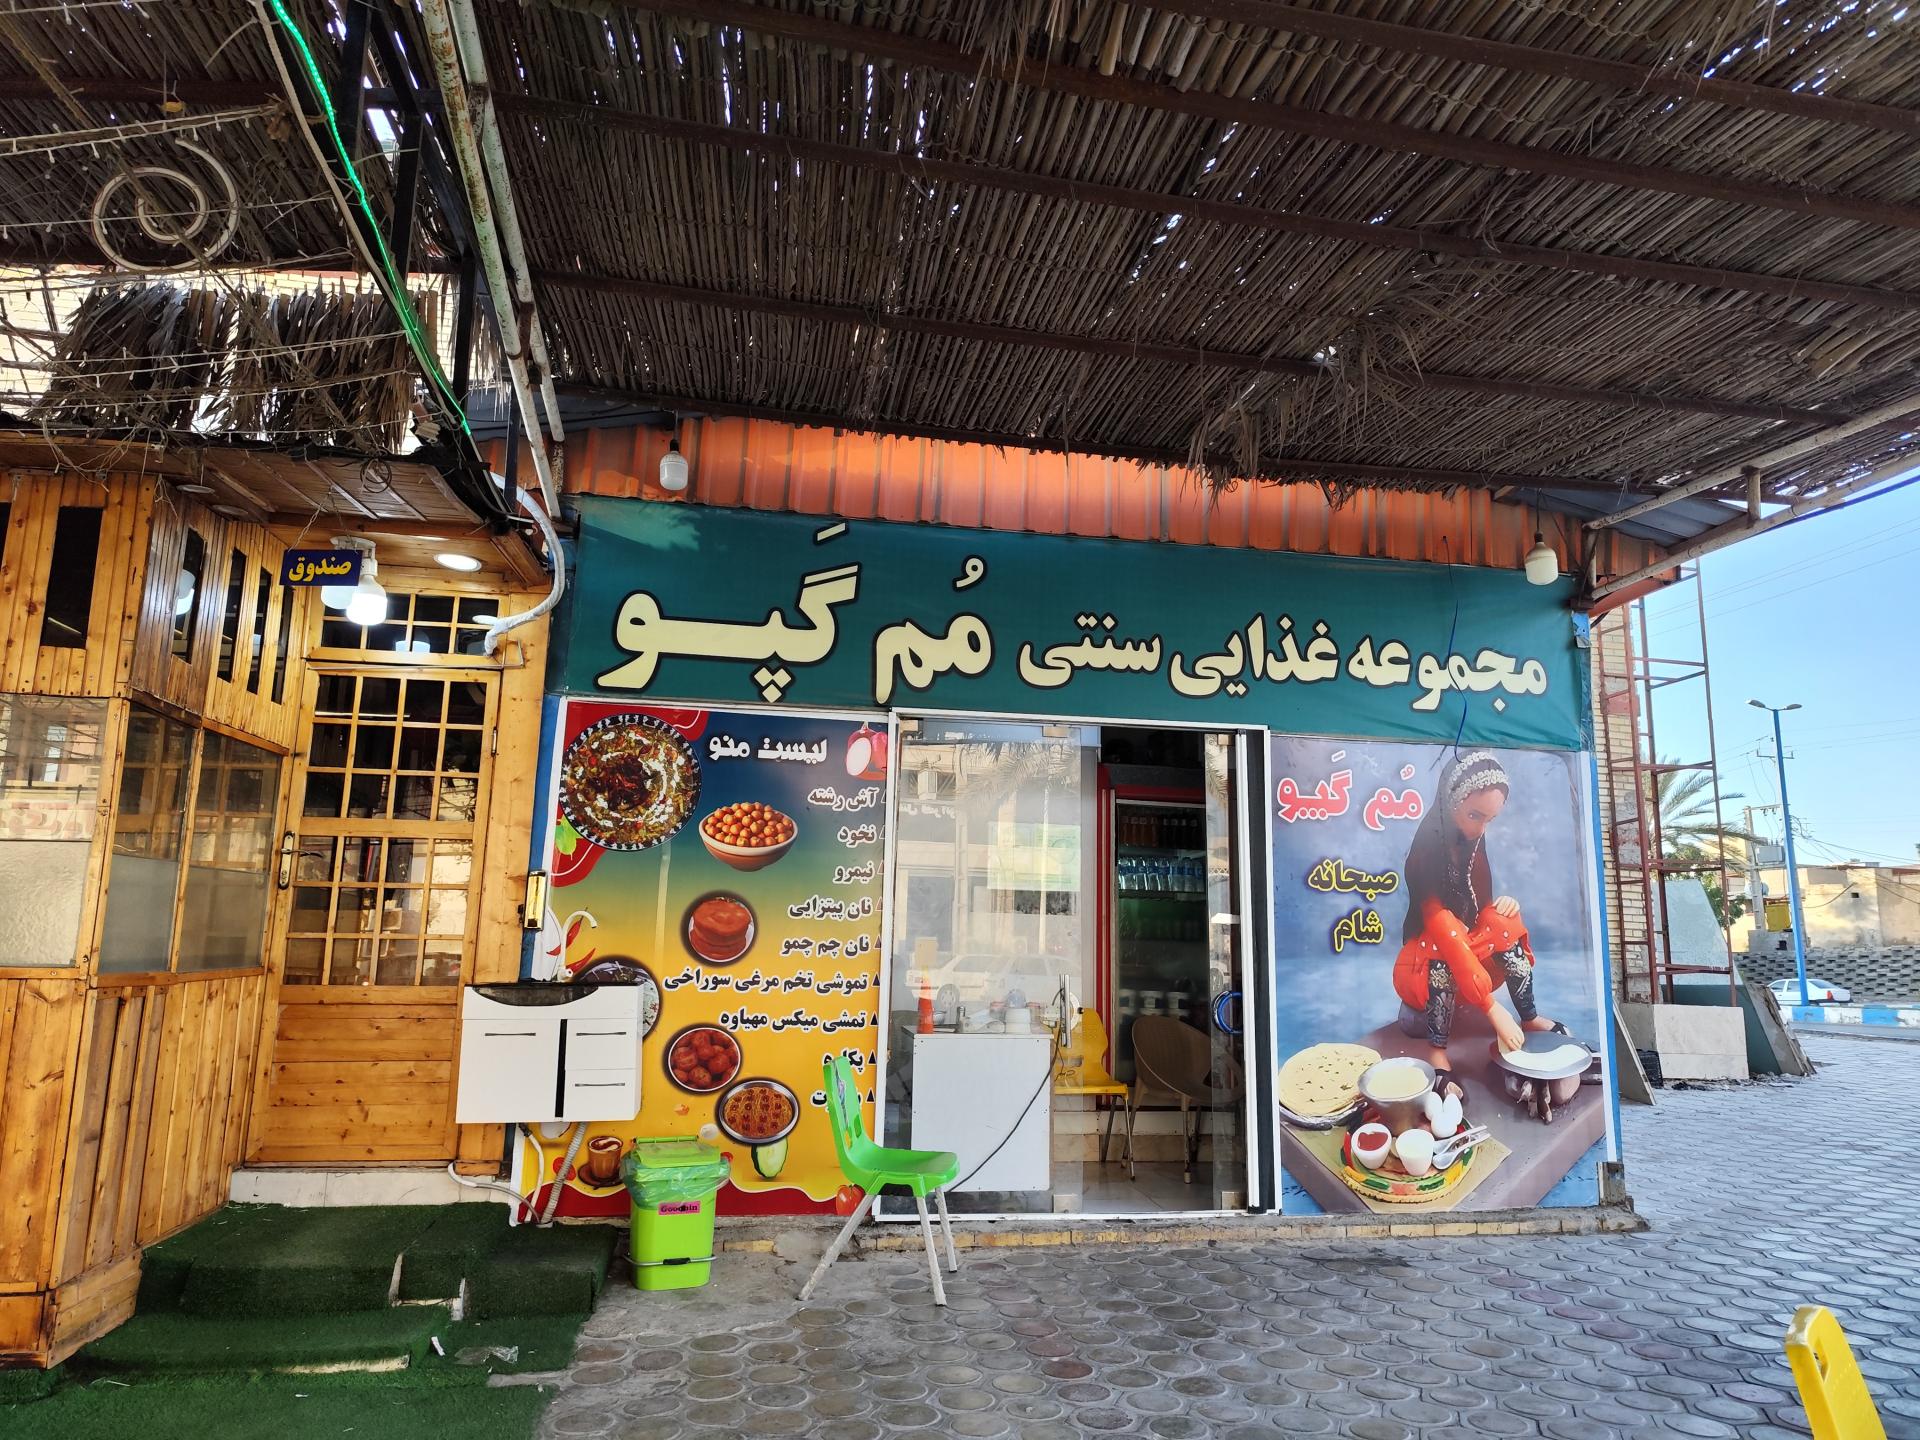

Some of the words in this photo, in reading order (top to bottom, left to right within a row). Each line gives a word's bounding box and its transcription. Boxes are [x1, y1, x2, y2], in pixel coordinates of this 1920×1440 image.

[288, 556, 352, 582] صندوق
[1017, 611, 1163, 689] سنتی
[1169, 612, 1339, 698] غذایی
[1346, 632, 1548, 713] مجموعه
[709, 735, 750, 761] منو
[758, 737, 828, 765] لیست
[808, 787, 845, 811] رشته
[846, 787, 879, 811] آش
[838, 824, 877, 847] نخود
[833, 861, 874, 883] نیمرو
[1308, 859, 1399, 901] صبحانه
[788, 895, 844, 921] پیتزایی
[847, 897, 872, 920] نان
[1334, 909, 1384, 952] شام
[781, 937, 814, 956] چمو
[817, 938, 841, 957] چم
[844, 935, 870, 957] نان
[664, 968, 731, 990] سوراخی
[734, 970, 780, 992] مرغی
[784, 972, 813, 993] تخم
[816, 973, 868, 995] تموشی
[720, 1008, 768, 1031] مهیاوه
[772, 1010, 818, 1031] میکس
[822, 1011, 866, 1032] تمشی
